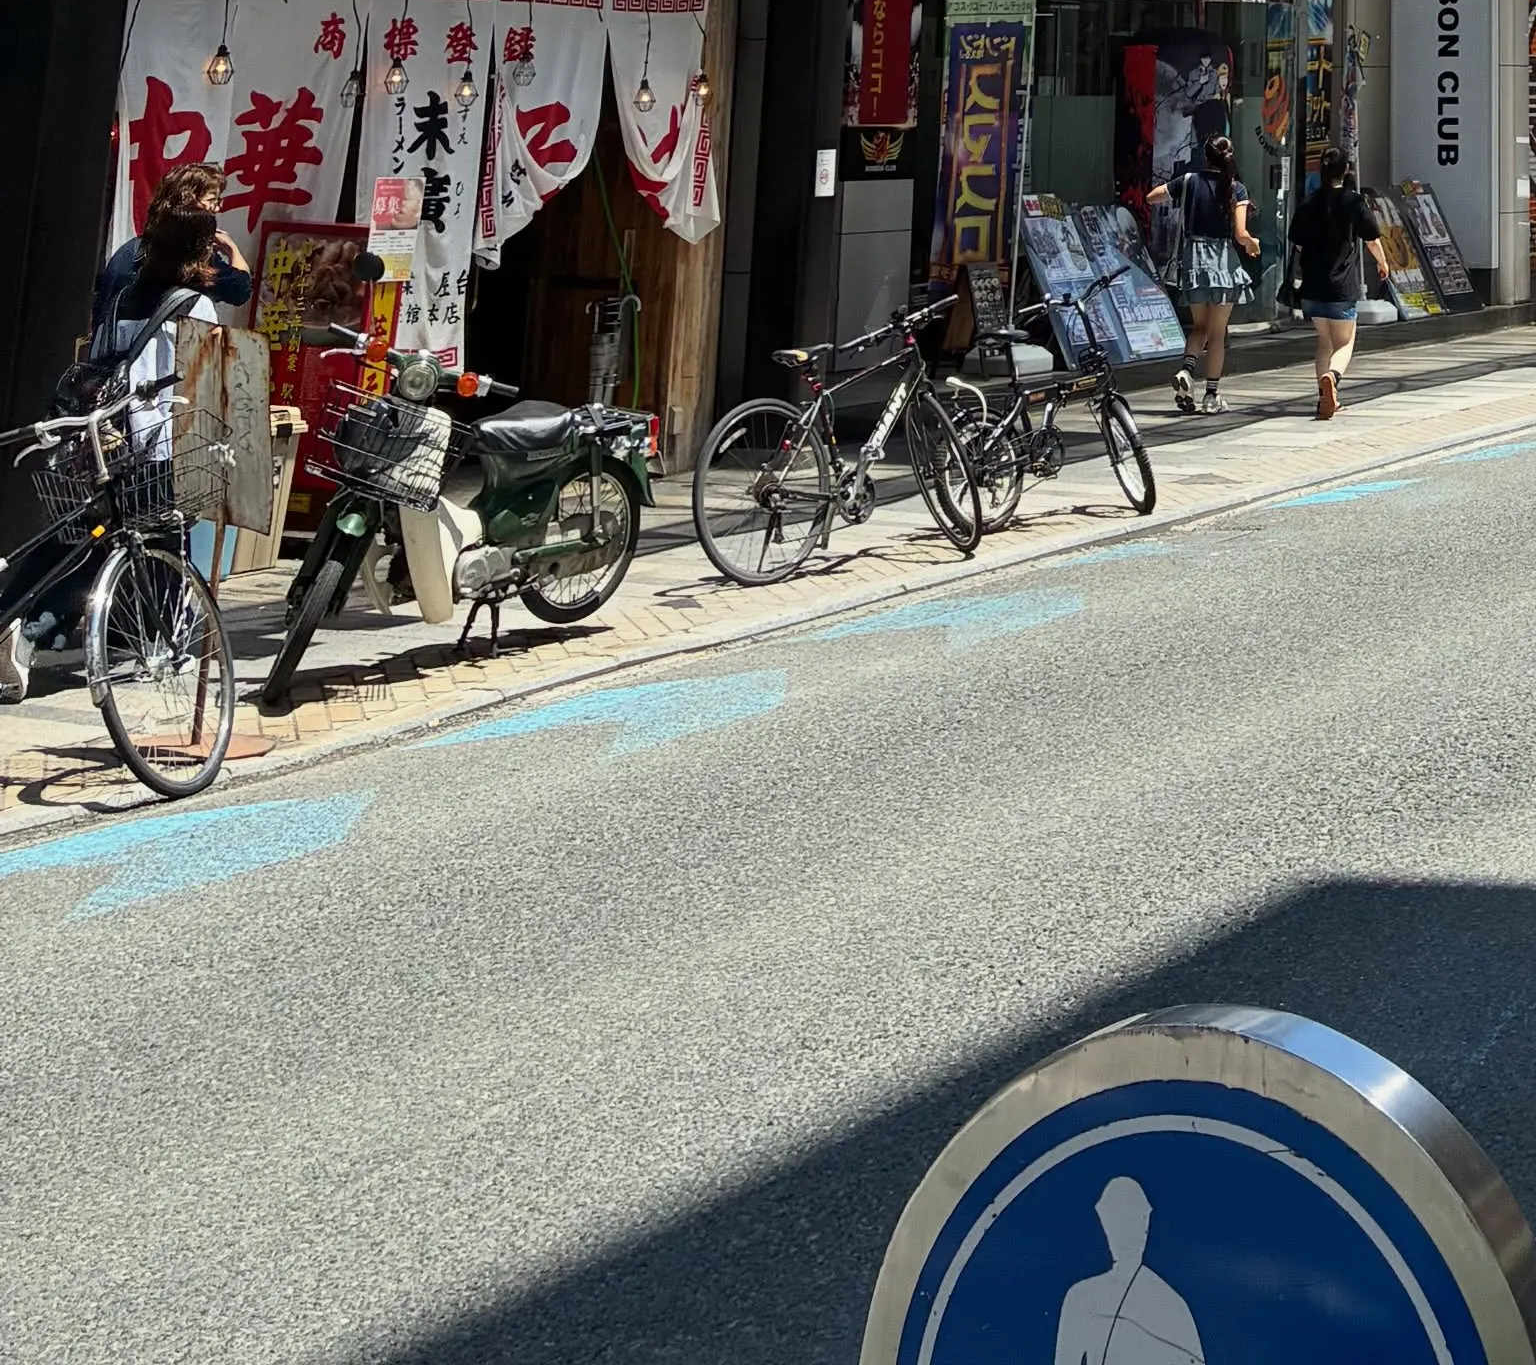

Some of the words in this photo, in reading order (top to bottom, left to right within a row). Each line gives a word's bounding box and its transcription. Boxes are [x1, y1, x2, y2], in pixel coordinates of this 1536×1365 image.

[392, 97, 406, 174] ラーメン
[1437, 70, 1459, 167] CLUB
